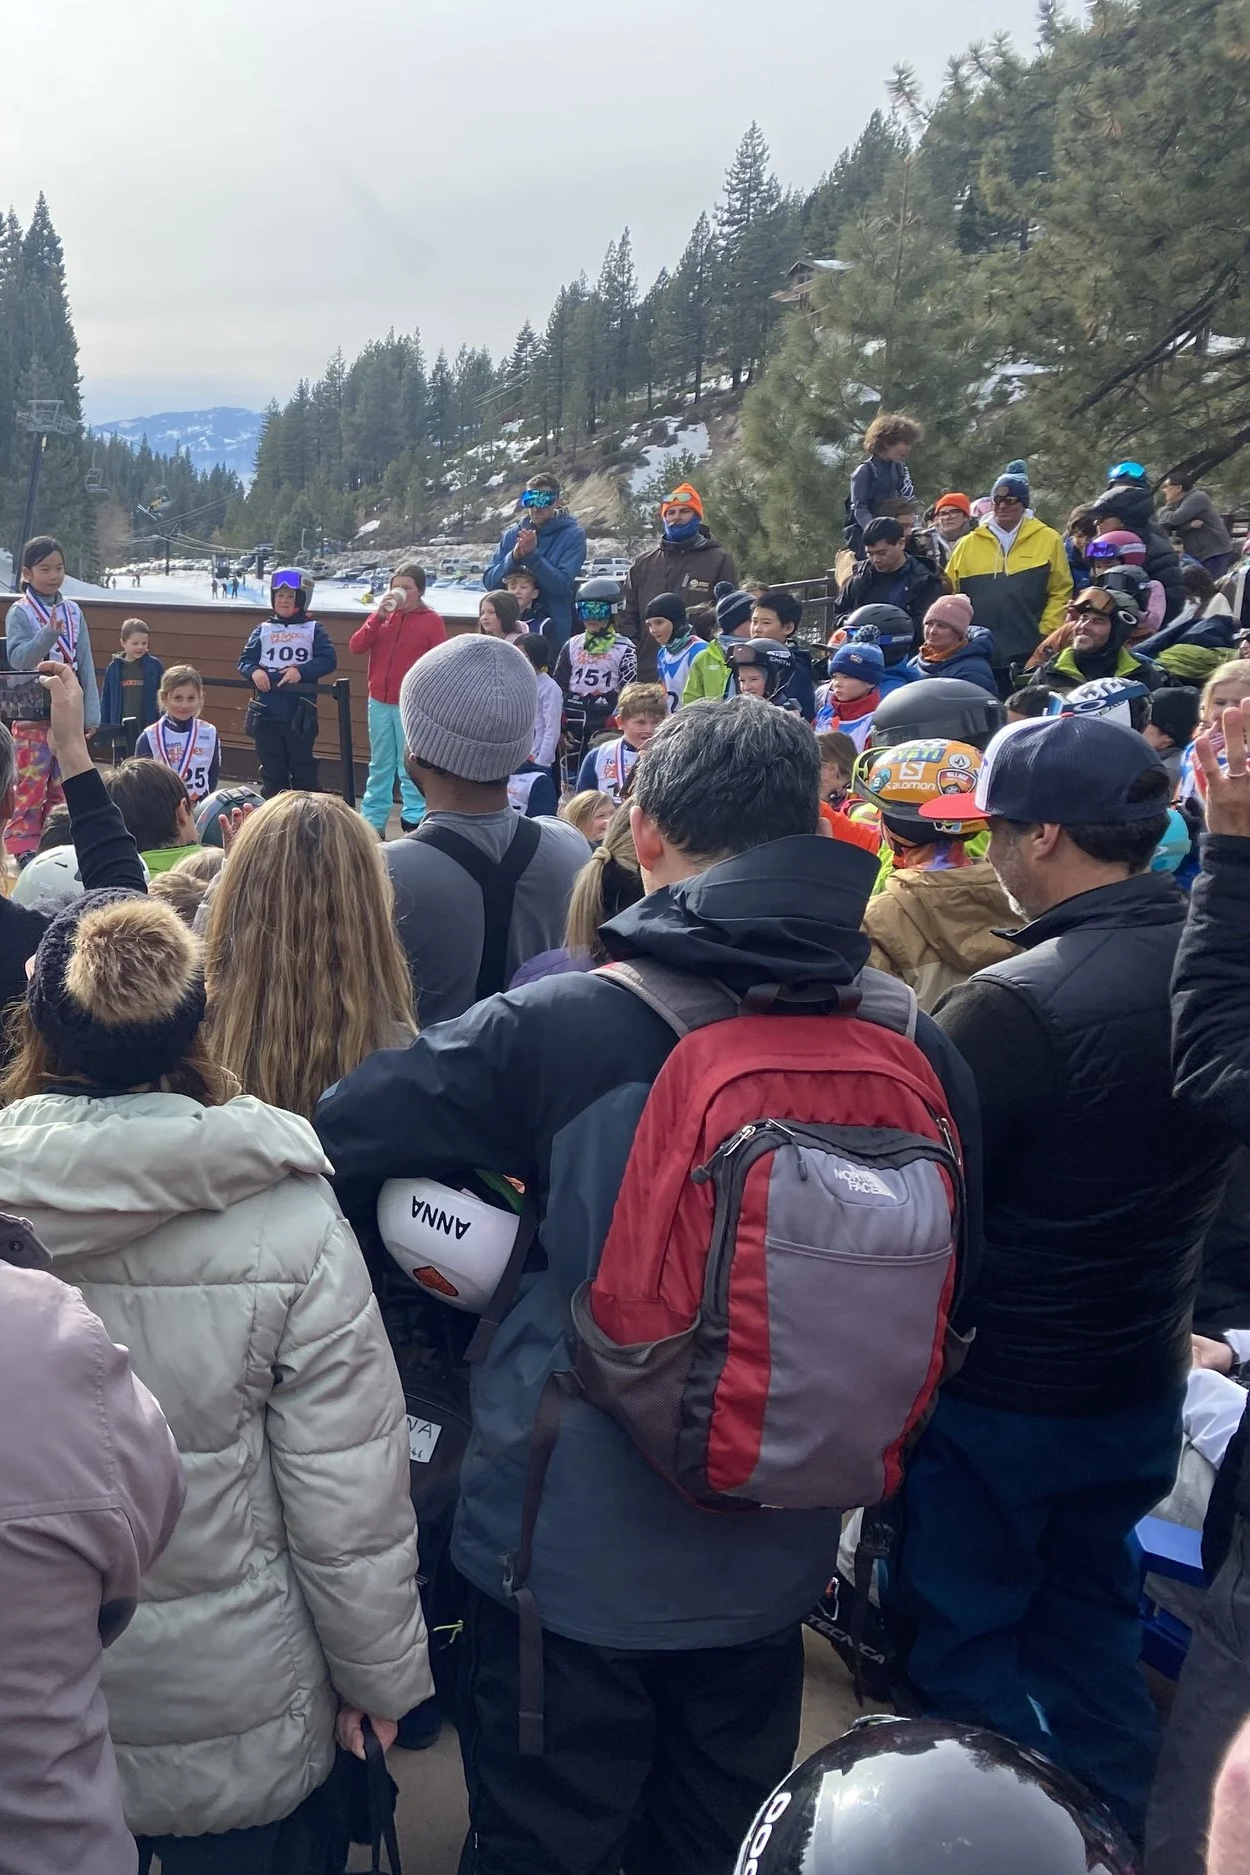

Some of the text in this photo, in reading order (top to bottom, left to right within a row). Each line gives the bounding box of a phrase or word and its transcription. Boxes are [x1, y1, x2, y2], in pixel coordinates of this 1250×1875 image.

[266, 646, 309, 662] 109
[575, 667, 612, 688] 151
[897, 748, 941, 760] YETI
[848, 1180, 882, 1195] FACE
[412, 1195, 472, 1240] ANNA
[809, 1614, 885, 1665] TECNCA
